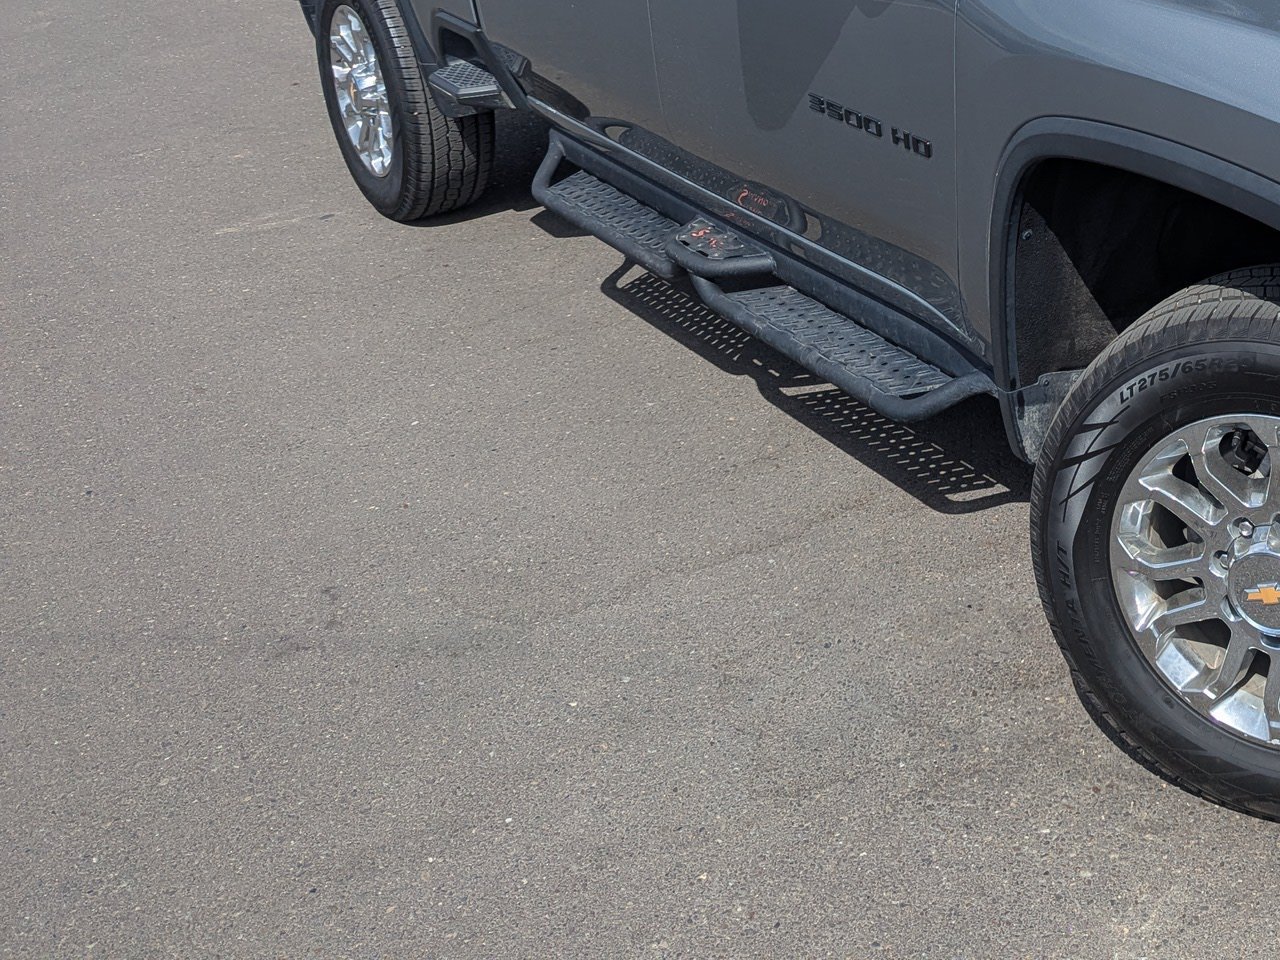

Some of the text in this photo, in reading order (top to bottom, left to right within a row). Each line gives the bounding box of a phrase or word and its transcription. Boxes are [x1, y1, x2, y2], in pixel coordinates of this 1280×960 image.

[808, 92, 933, 159] 3500 HD
[1056, 540, 1072, 588] H/T
